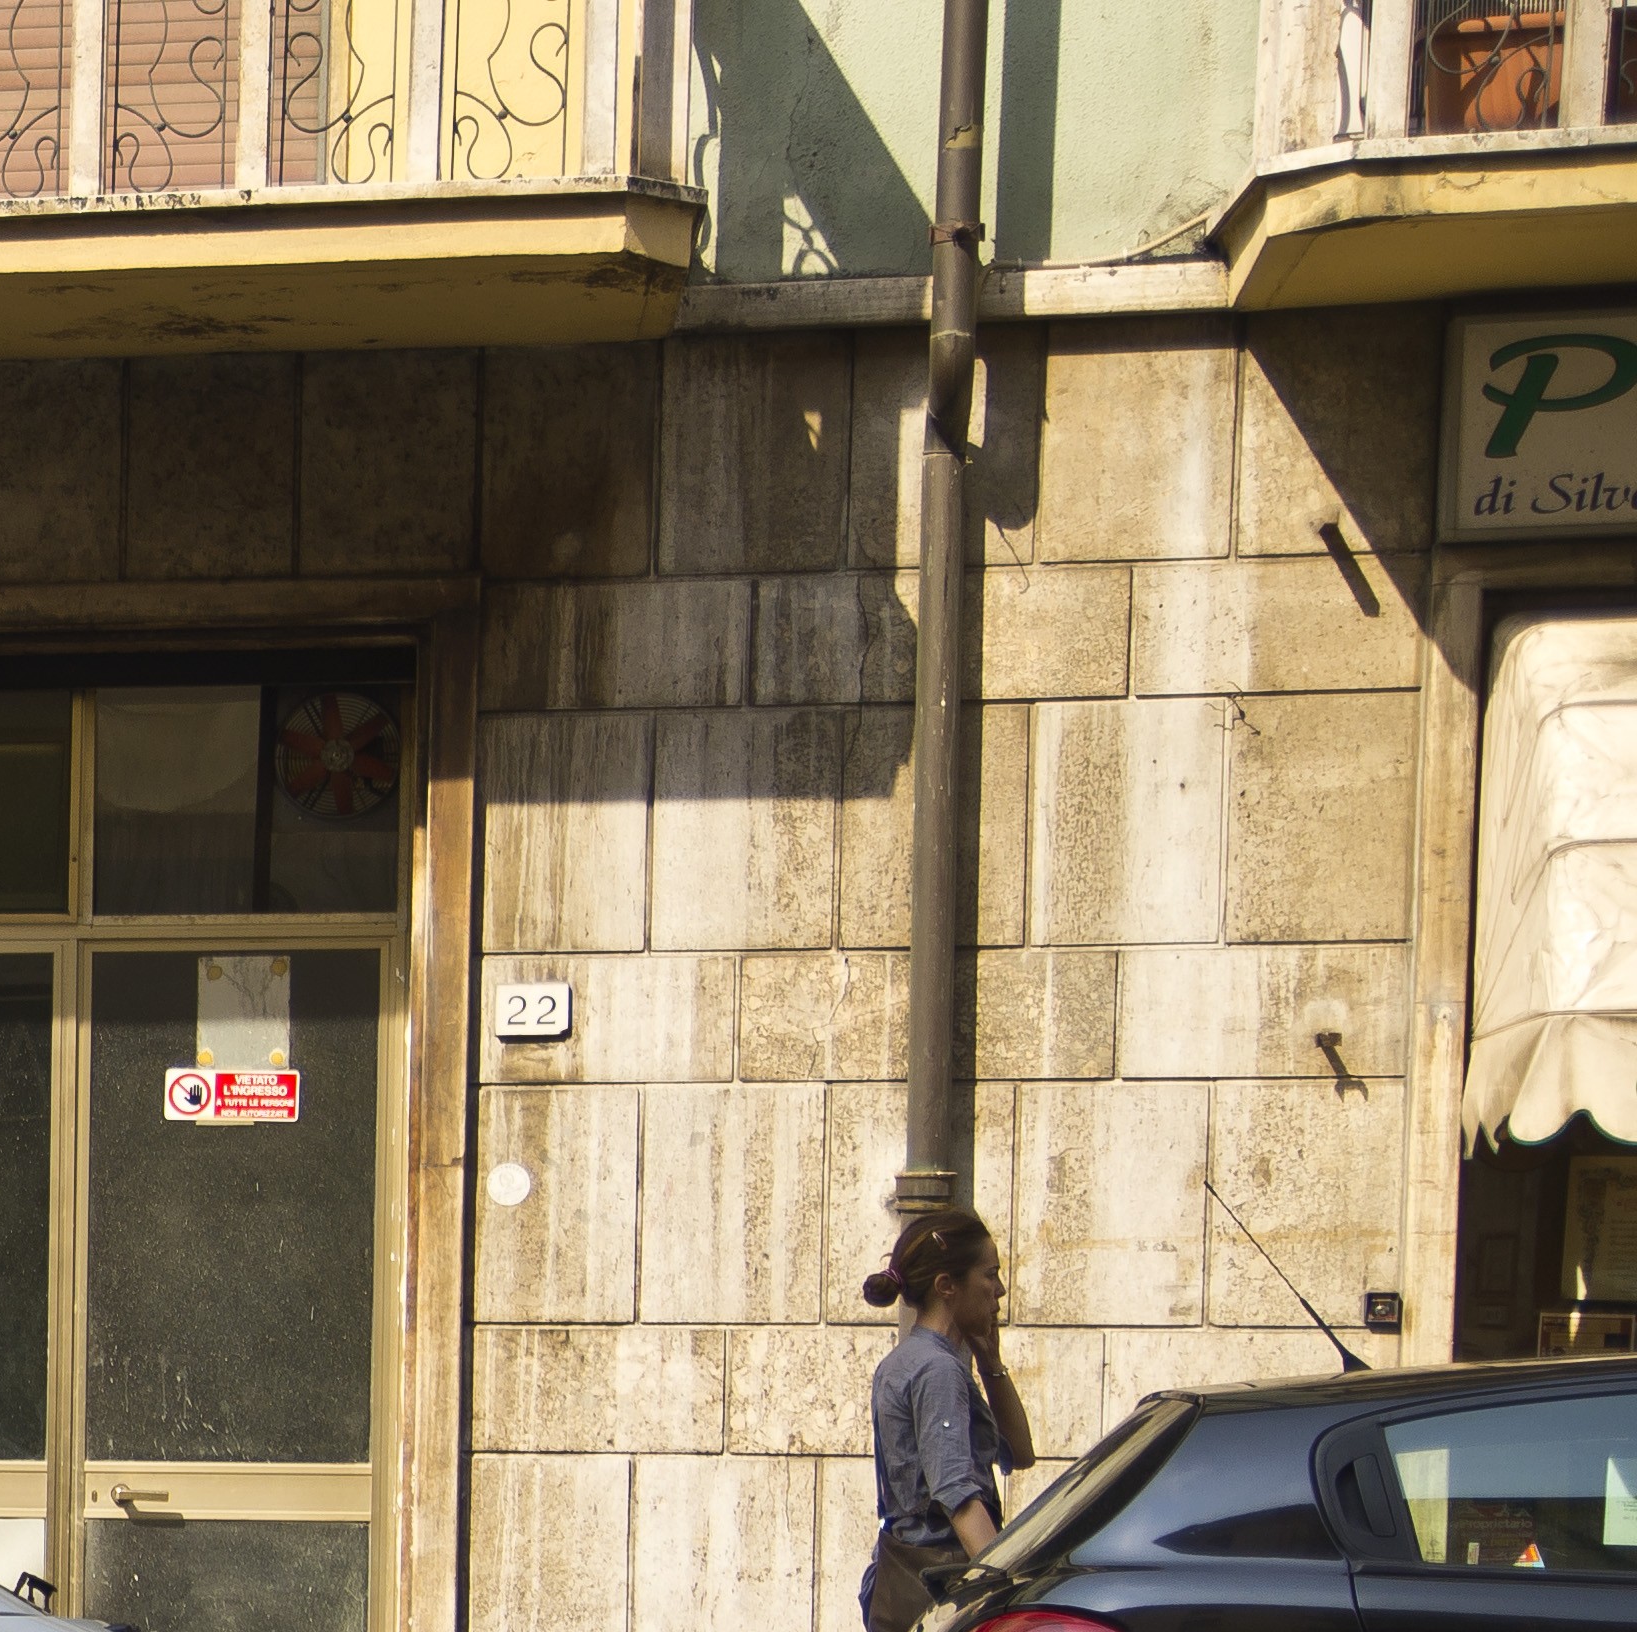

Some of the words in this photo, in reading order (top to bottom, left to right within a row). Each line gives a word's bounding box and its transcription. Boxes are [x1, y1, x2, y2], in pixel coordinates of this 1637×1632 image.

[1482, 333, 1637, 458] P
[1474, 475, 1517, 516] di
[1530, 471, 1637, 515] Silv
[507, 995, 556, 1025] 22
[235, 1074, 278, 1085] VIETATO
[223, 1085, 288, 1097] L'INGRESSO
[216, 1098, 222, 1107] A
[224, 1098, 248, 1107] TUTTE
[249, 1098, 259, 1107] LE
